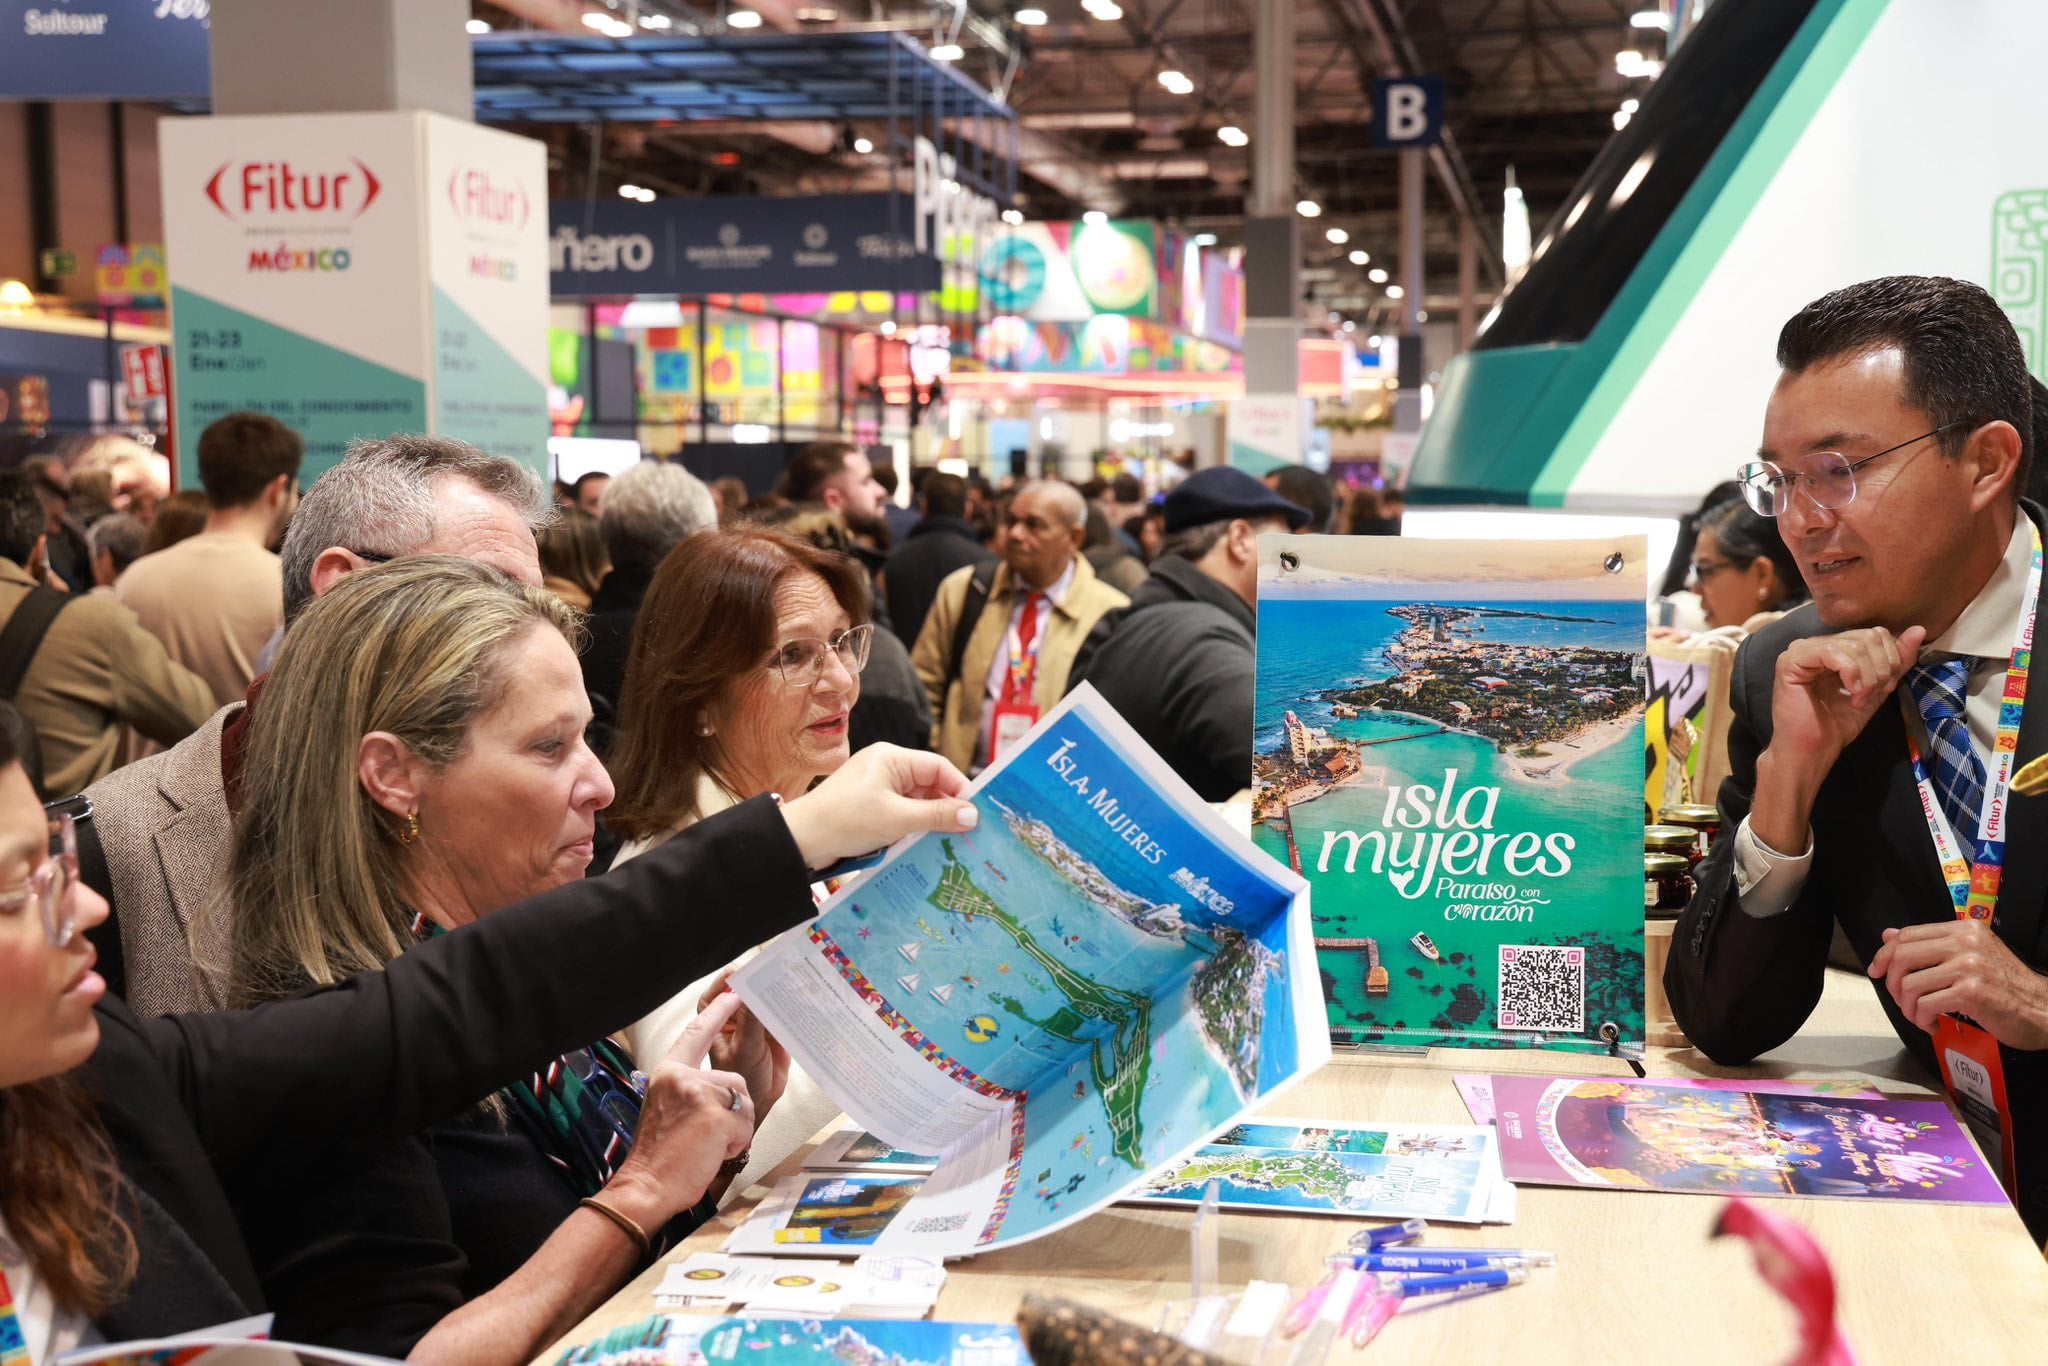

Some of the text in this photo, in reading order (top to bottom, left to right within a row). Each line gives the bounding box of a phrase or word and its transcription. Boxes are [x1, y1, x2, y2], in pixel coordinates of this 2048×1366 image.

[1387, 84, 1427, 140] B
[1046, 737, 1167, 864] ISLA MUJERES
[1382, 768, 1501, 829] isla
[1318, 830, 1576, 899] mujeres
[1520, 889, 1540, 898] con
